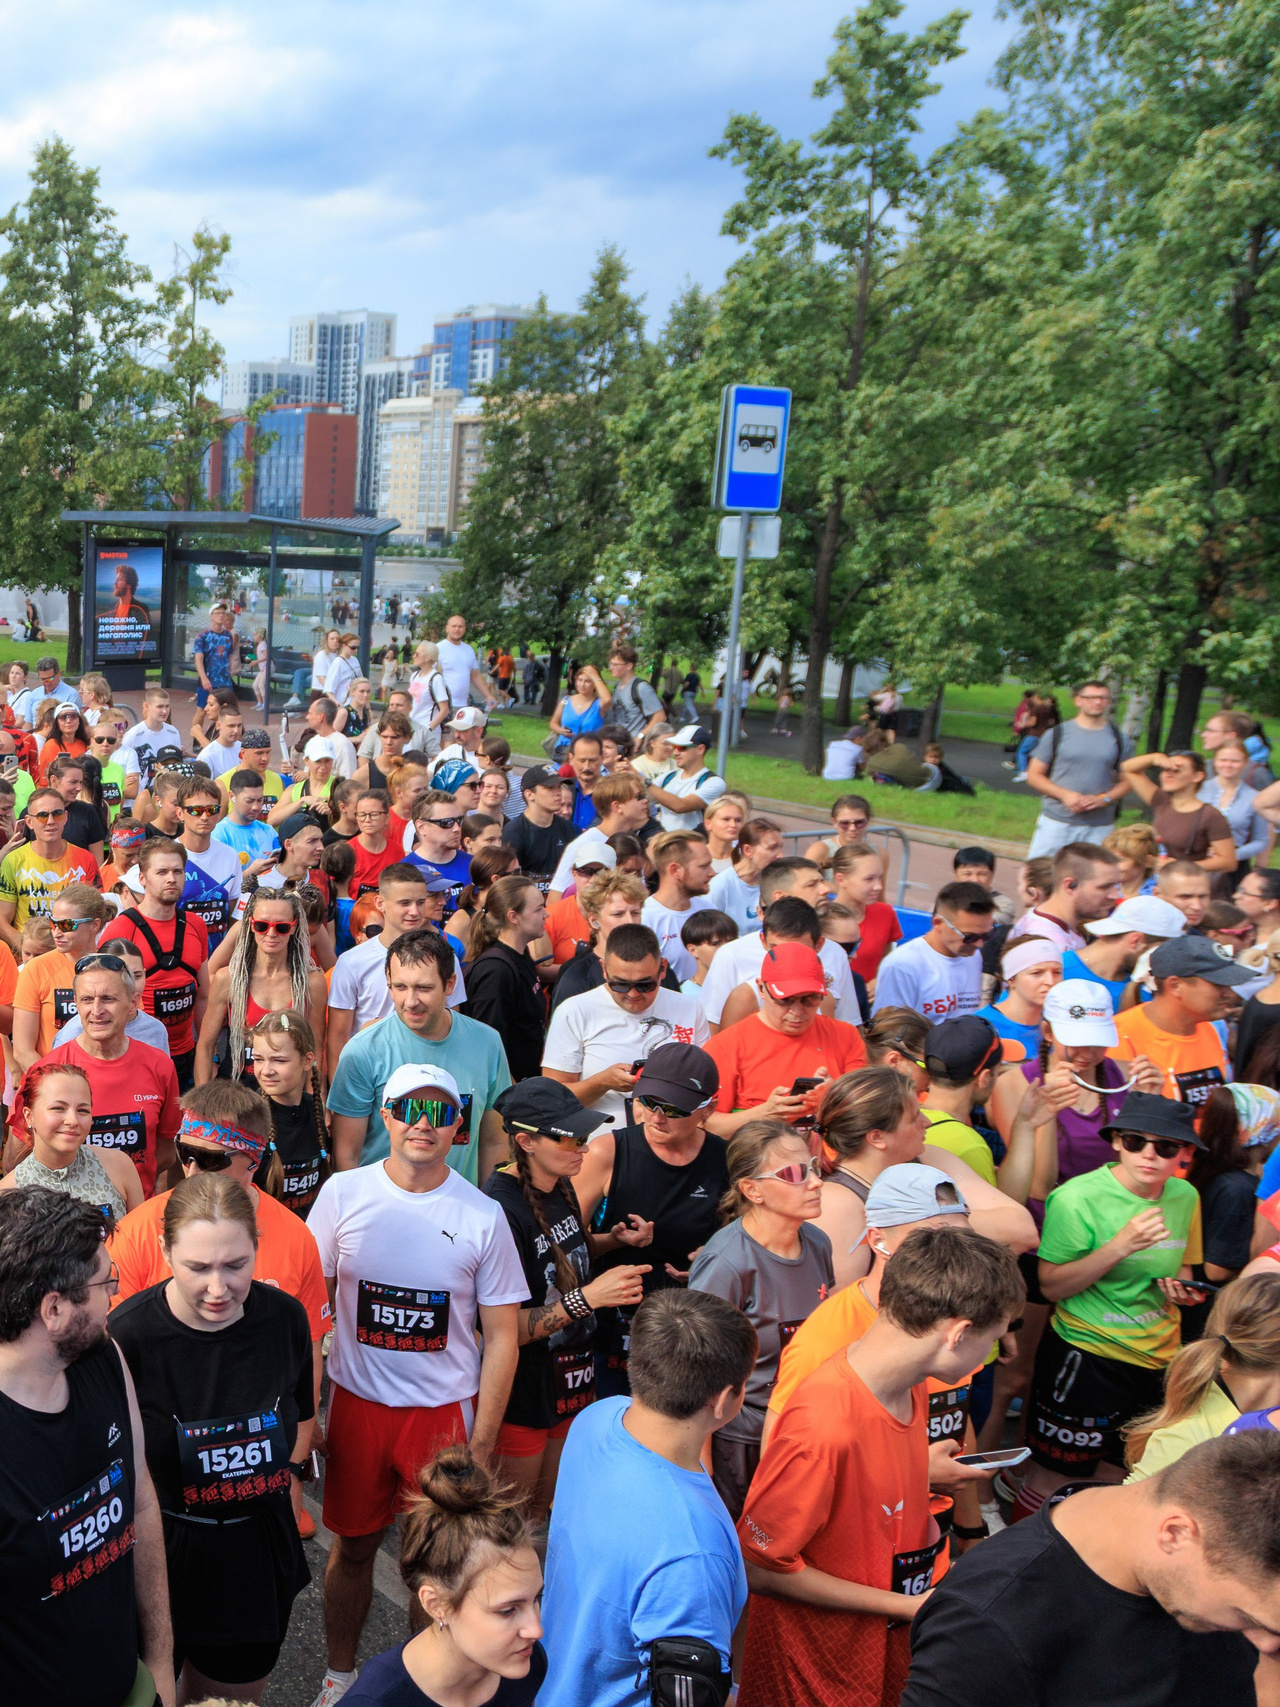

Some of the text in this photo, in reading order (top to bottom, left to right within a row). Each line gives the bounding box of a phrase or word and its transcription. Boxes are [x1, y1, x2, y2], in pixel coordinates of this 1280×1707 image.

[98, 624, 134, 633] деревня
[161, 995, 193, 1012] 16991
[283, 1171, 319, 1192] 15419
[372, 1304, 435, 1329] 15173
[394, 1326, 410, 1334] DINAR
[1038, 1417, 1103, 1447] 17092
[198, 1440, 272, 1474] 15261
[222, 1467, 255, 1479] ЕКАТЕРИНА
[59, 1497, 123, 1558] 15260
[86, 1535, 106, 1552] НИКИТА
[751, 1534, 769, 1551] RUN
